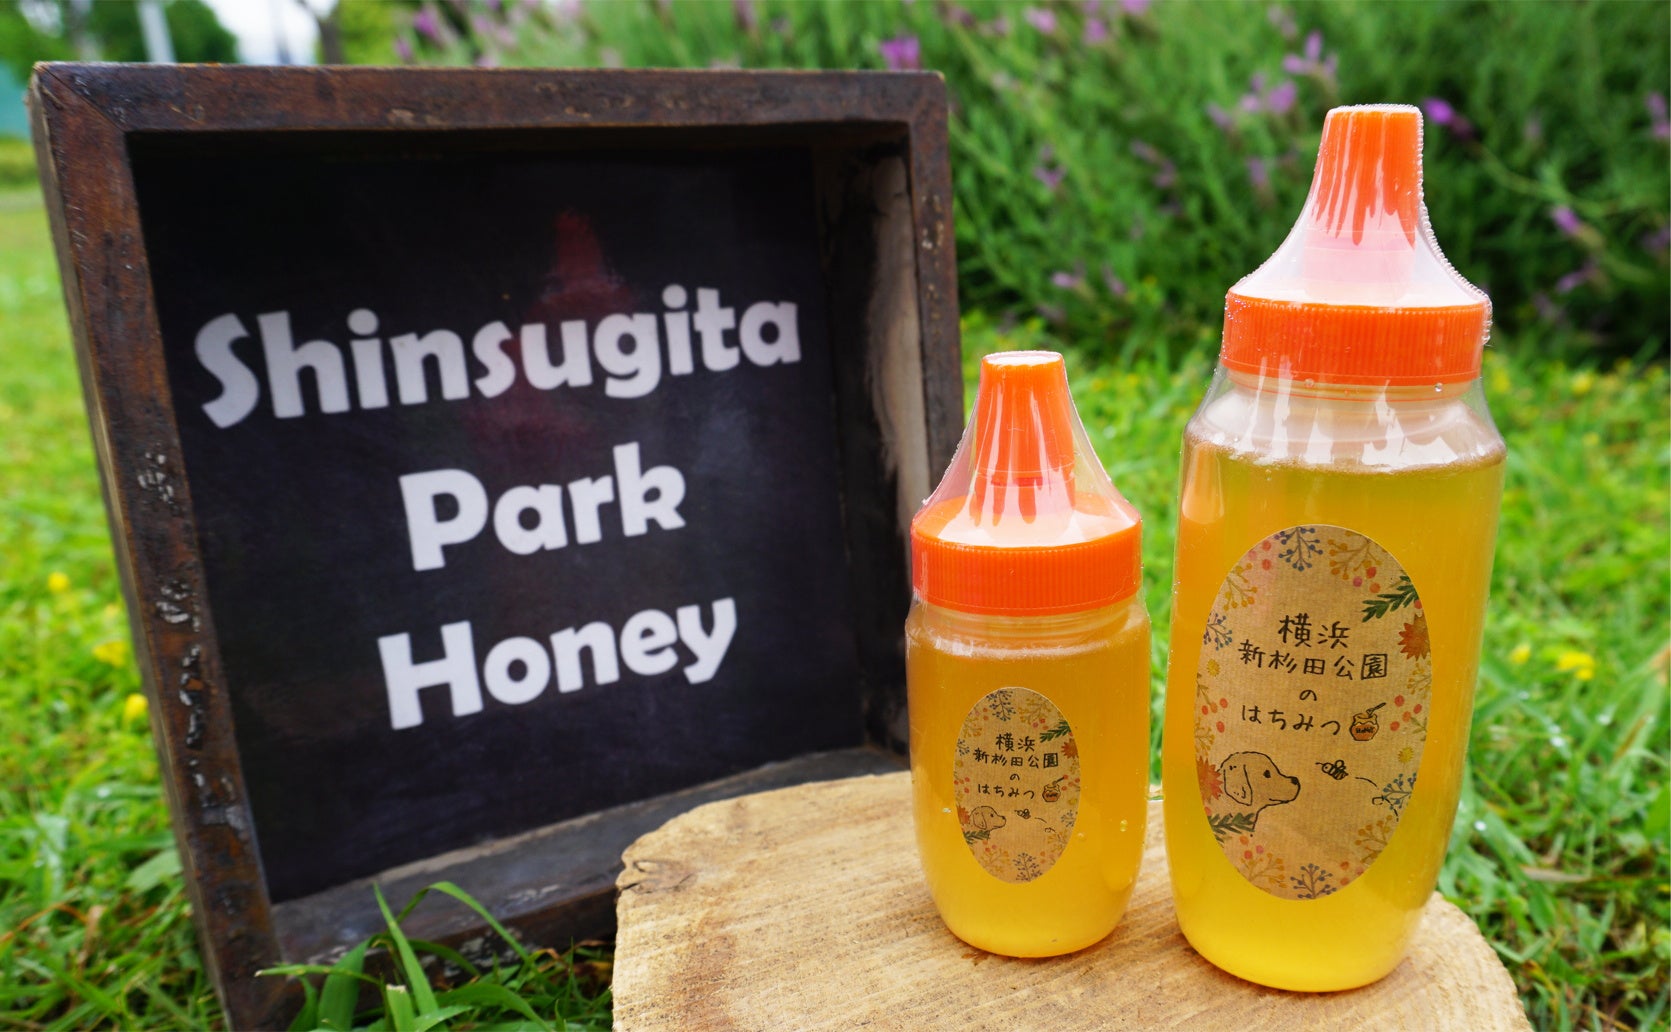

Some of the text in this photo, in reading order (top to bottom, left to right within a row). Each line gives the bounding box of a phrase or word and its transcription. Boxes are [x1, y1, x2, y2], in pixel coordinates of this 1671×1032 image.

[194, 284, 802, 430] Shinsugita
[399, 442, 687, 572] Park
[1278, 612, 1350, 649] 横浜
[377, 597, 739, 731] Honey
[1238, 639, 1388, 681] 新杉田公園
[1299, 689, 1318, 702] の
[1242, 704, 1341, 736] はちみつ
[973, 747, 1059, 768] 新杉田公園
[995, 732, 1035, 752] 横浜
[977, 783, 1035, 799] はちみつ
[1009, 773, 1020, 781] の
